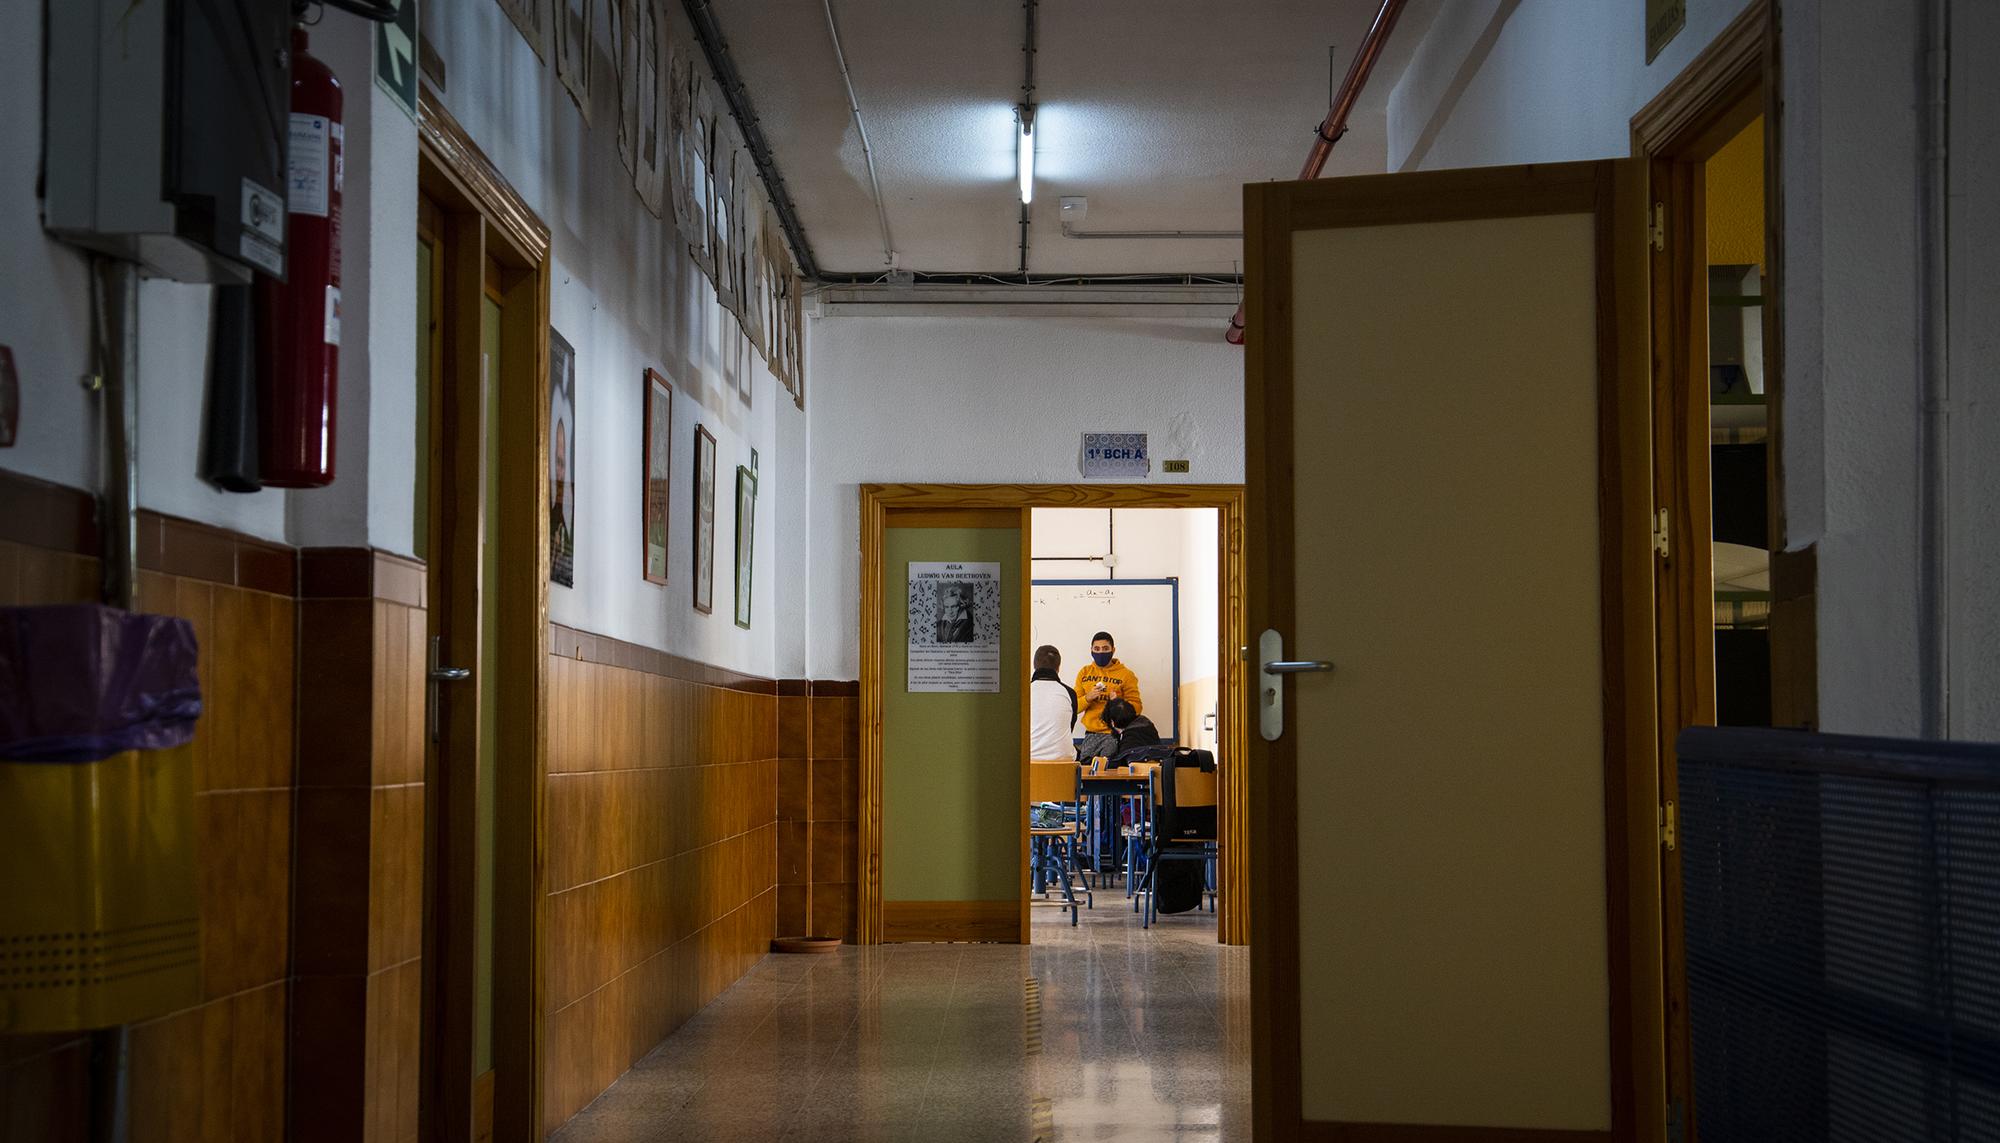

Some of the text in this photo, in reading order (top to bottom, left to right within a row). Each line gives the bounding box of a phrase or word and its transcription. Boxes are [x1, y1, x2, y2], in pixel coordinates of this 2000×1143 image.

[1104, 448, 1130, 459] BCH
[1135, 448, 1143, 459] A
[1169, 462, 1186, 471] 108
[1103, 675, 1123, 685] STOP
